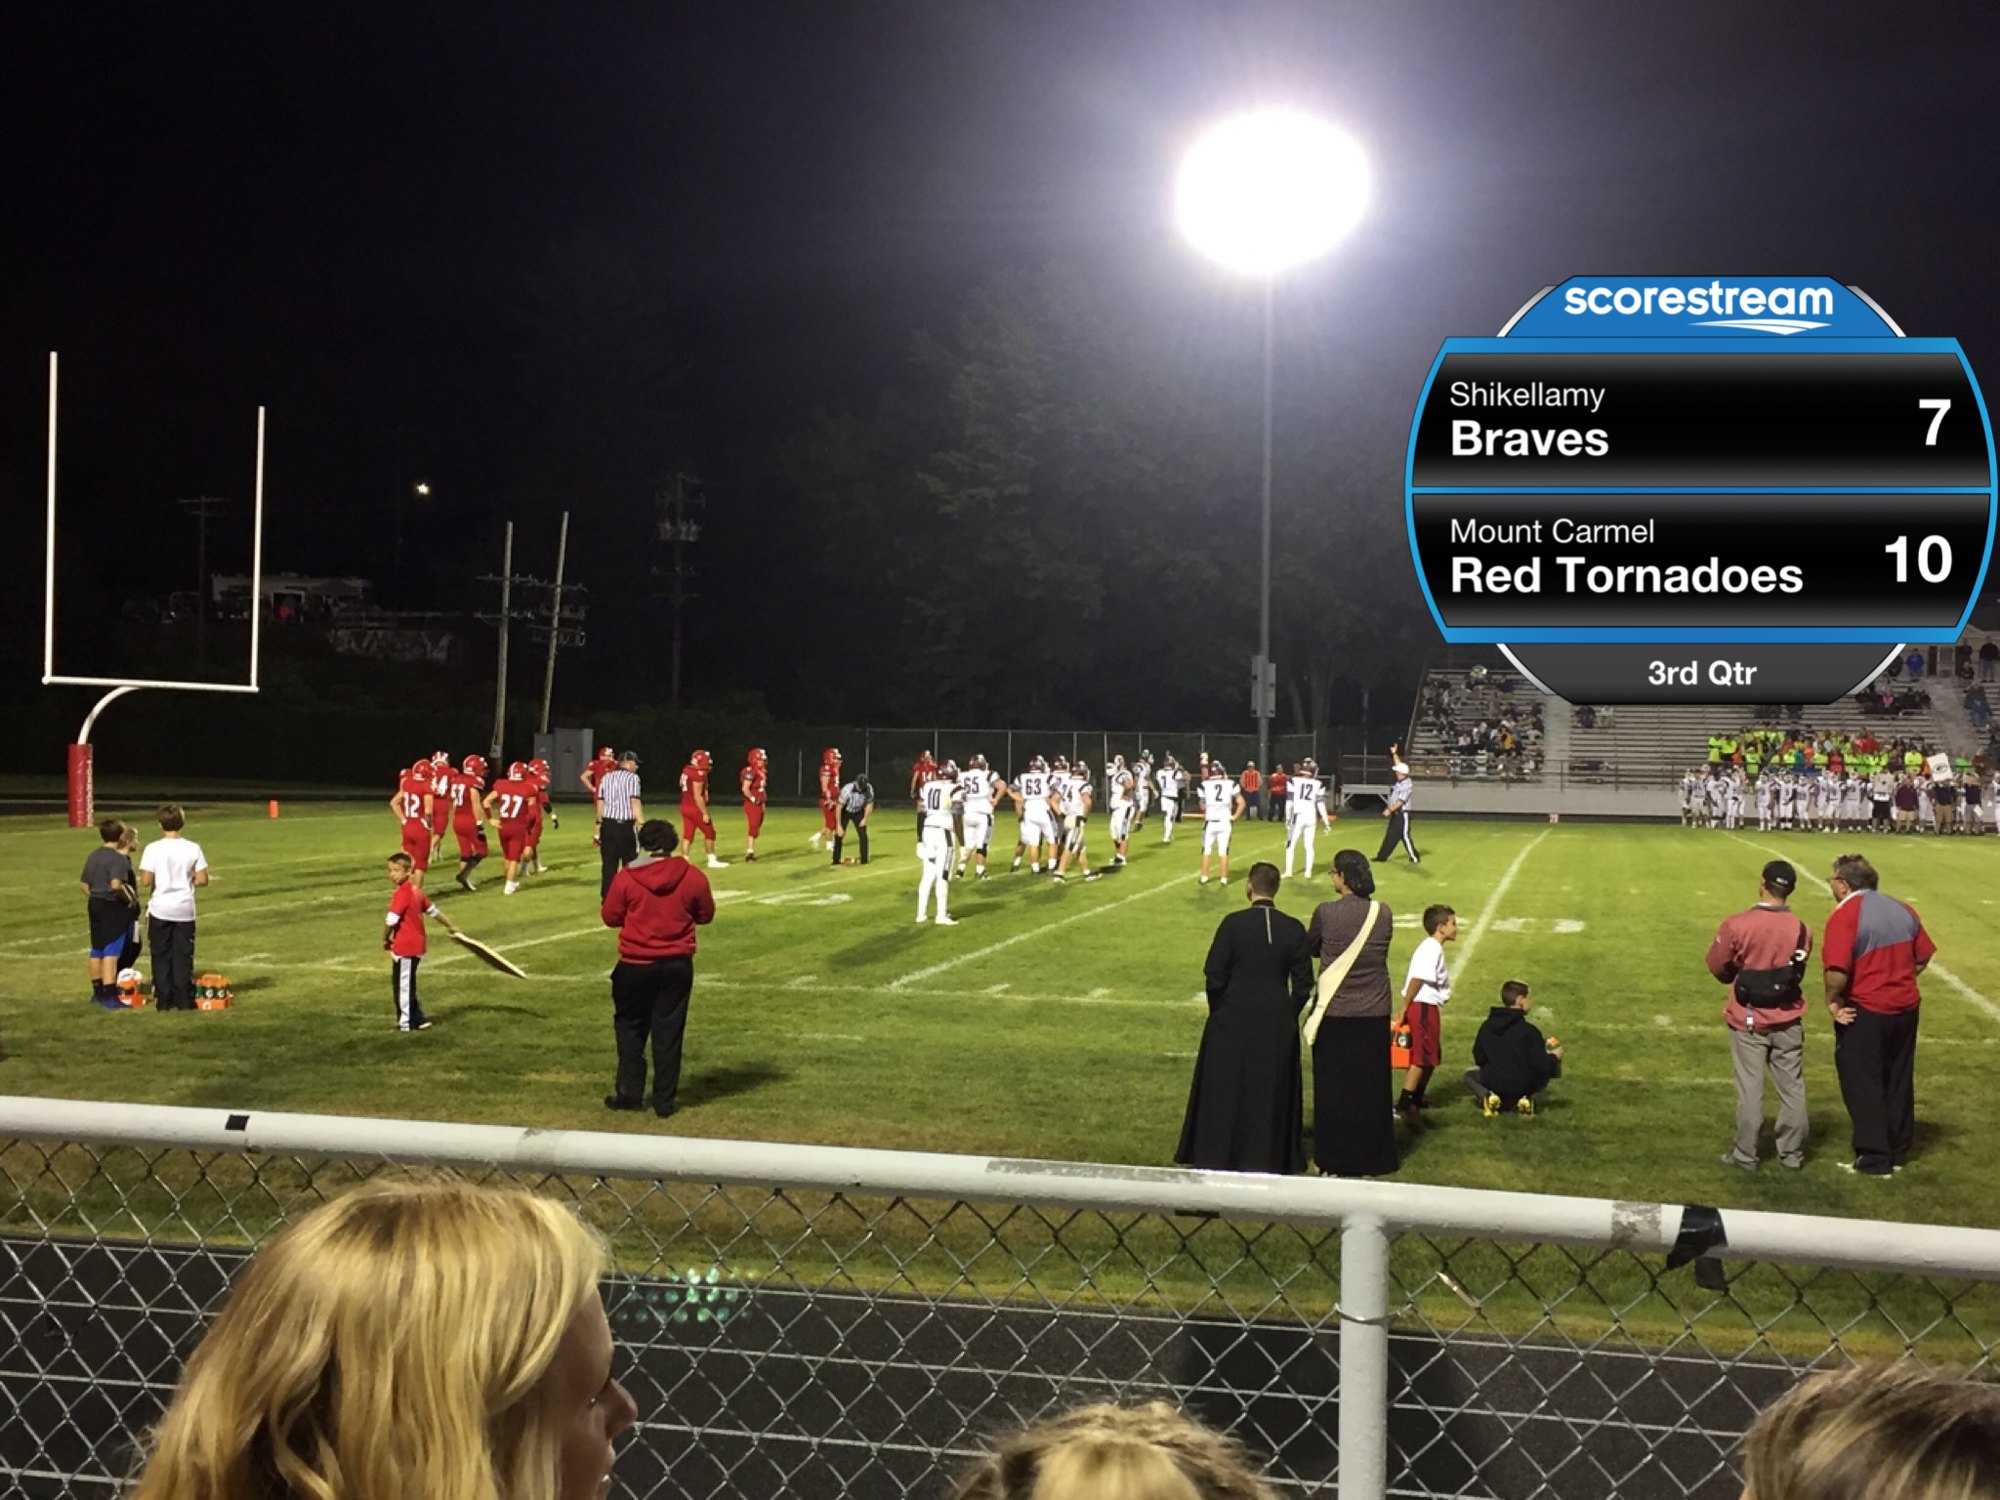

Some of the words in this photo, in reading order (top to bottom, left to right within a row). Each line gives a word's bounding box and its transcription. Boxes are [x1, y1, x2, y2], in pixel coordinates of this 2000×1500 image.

[963, 776, 980, 795] 65
[1025, 778, 1042, 796] 63
[1214, 784, 1224, 802] 2
[1299, 783, 1314, 801] 12
[402, 791, 421, 819] 12
[499, 793, 524, 819] 27
[927, 786, 942, 811] 10
